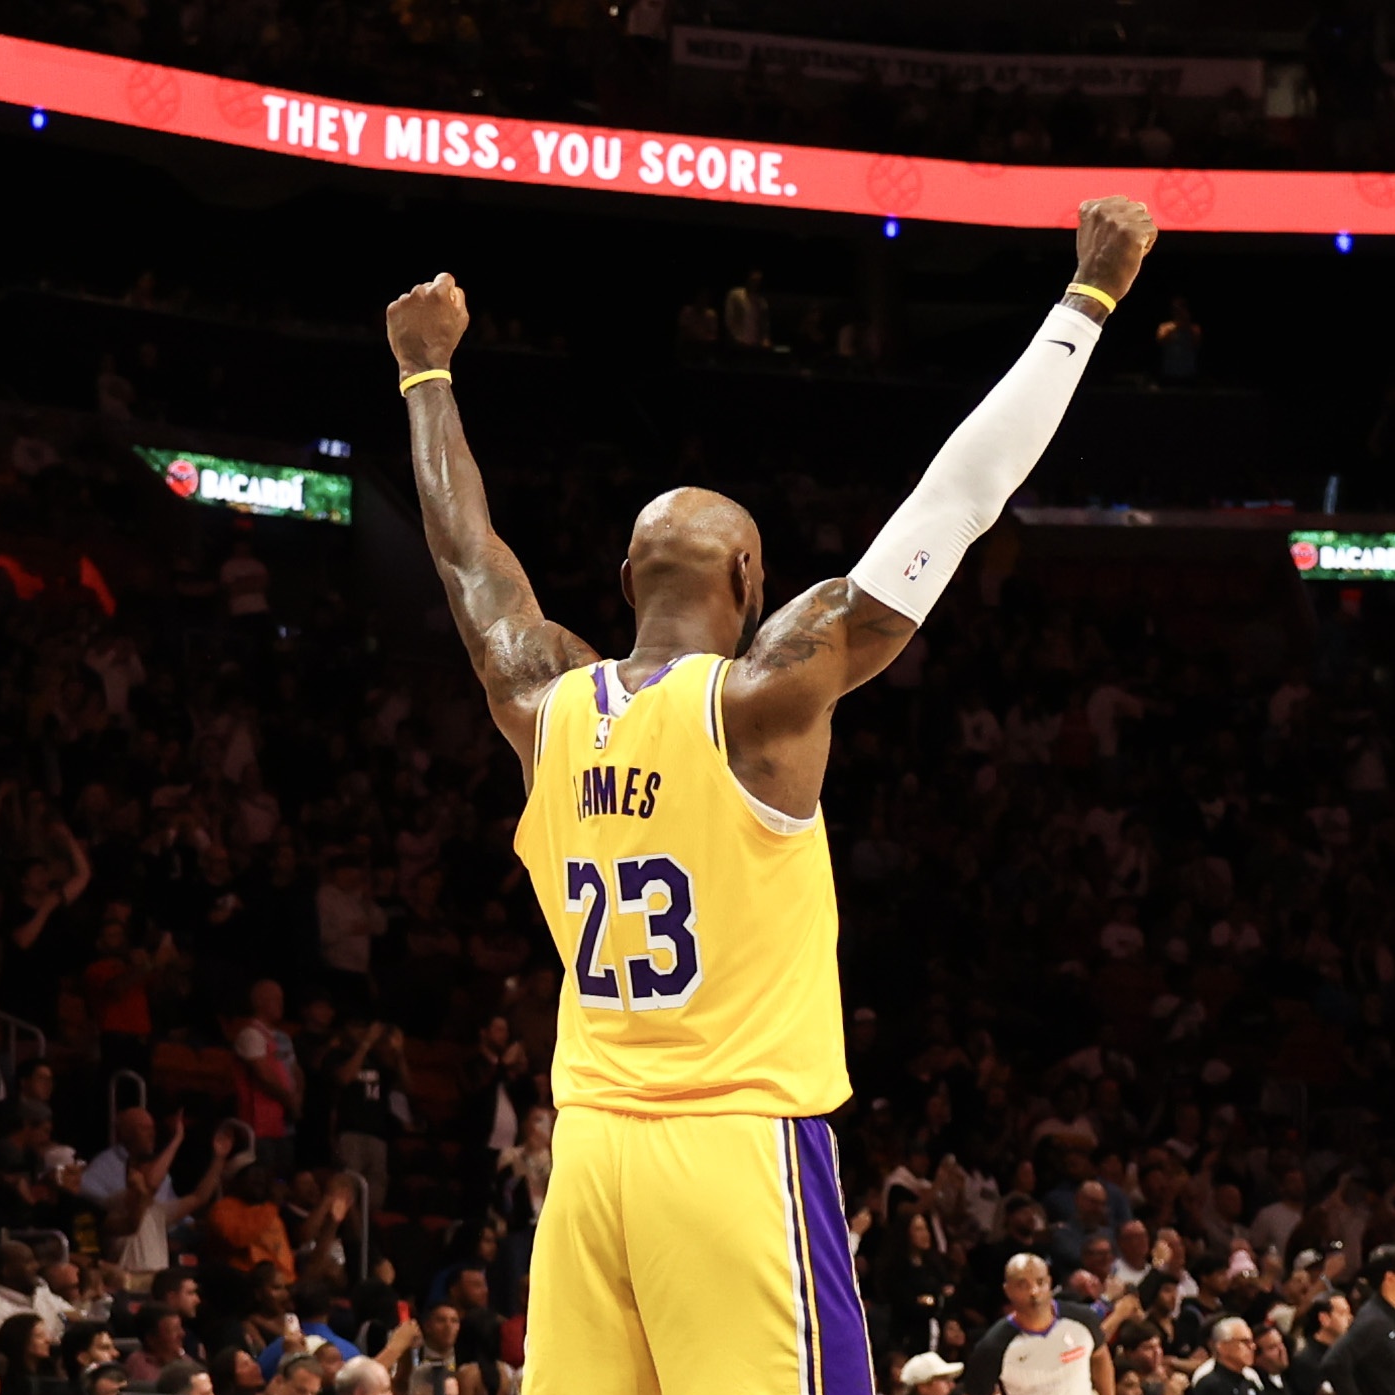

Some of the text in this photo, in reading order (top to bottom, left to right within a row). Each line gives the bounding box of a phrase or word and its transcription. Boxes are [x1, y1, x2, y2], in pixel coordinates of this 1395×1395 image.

[262, 95, 797, 197] THEY MISS. YOU SCORE.
[573, 766, 661, 823] AMES
[565, 853, 703, 1012] 23
